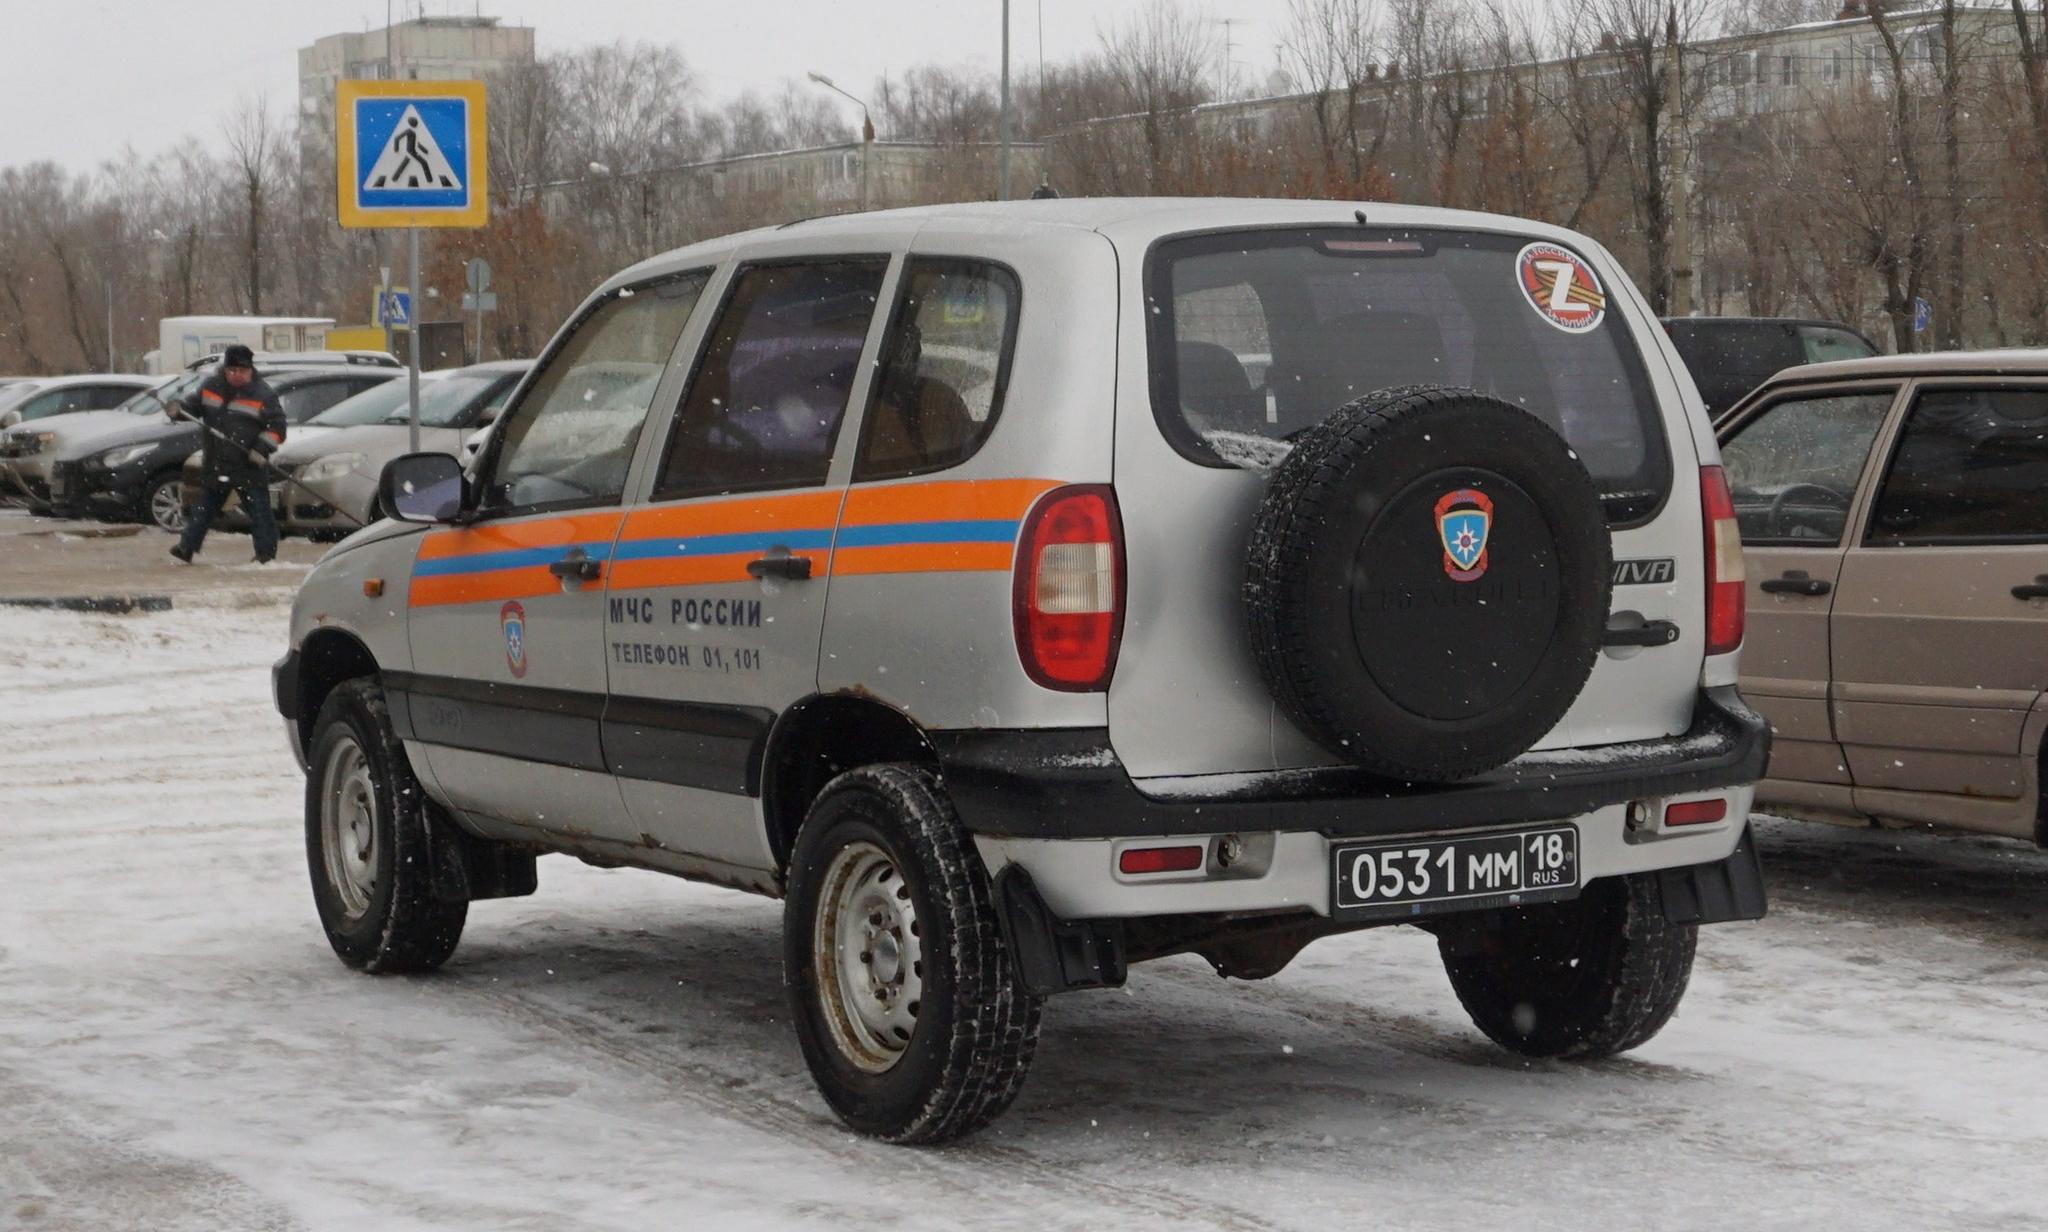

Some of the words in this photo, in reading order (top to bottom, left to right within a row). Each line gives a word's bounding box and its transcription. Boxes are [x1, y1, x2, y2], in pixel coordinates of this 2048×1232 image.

[1535, 261, 1590, 311] Z
[1613, 561, 1673, 583] IVA
[610, 597, 652, 624] МЧС
[672, 598, 761, 627] РОССИИ
[612, 642, 690, 667] ТЕЛЕФОН
[1351, 846, 1455, 899] 0531
[1528, 834, 1564, 870] 18
[1531, 870, 1560, 885] RUS
